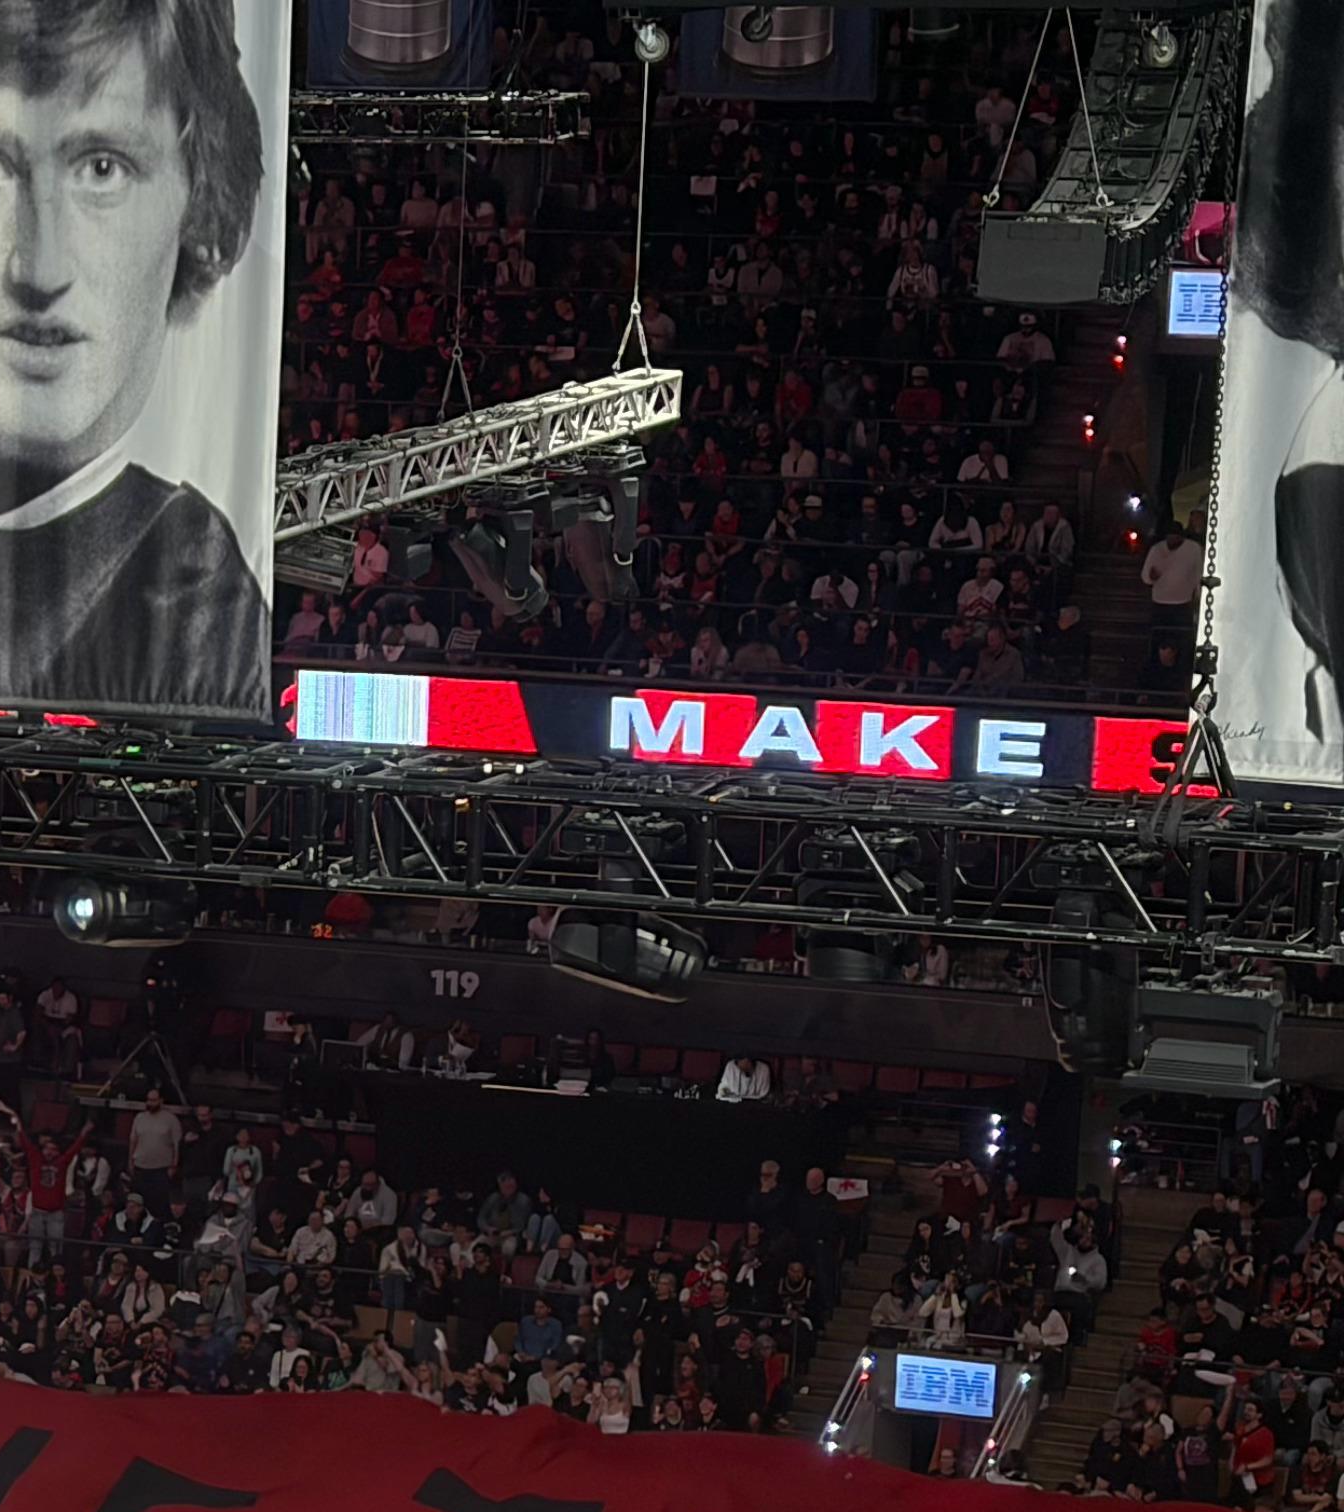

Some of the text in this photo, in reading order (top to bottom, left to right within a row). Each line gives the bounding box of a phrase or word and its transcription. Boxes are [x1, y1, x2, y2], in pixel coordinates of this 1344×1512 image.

[611, 696, 1046, 778] MAKE
[431, 969, 480, 998] 119
[900, 1364, 990, 1407] IBM
